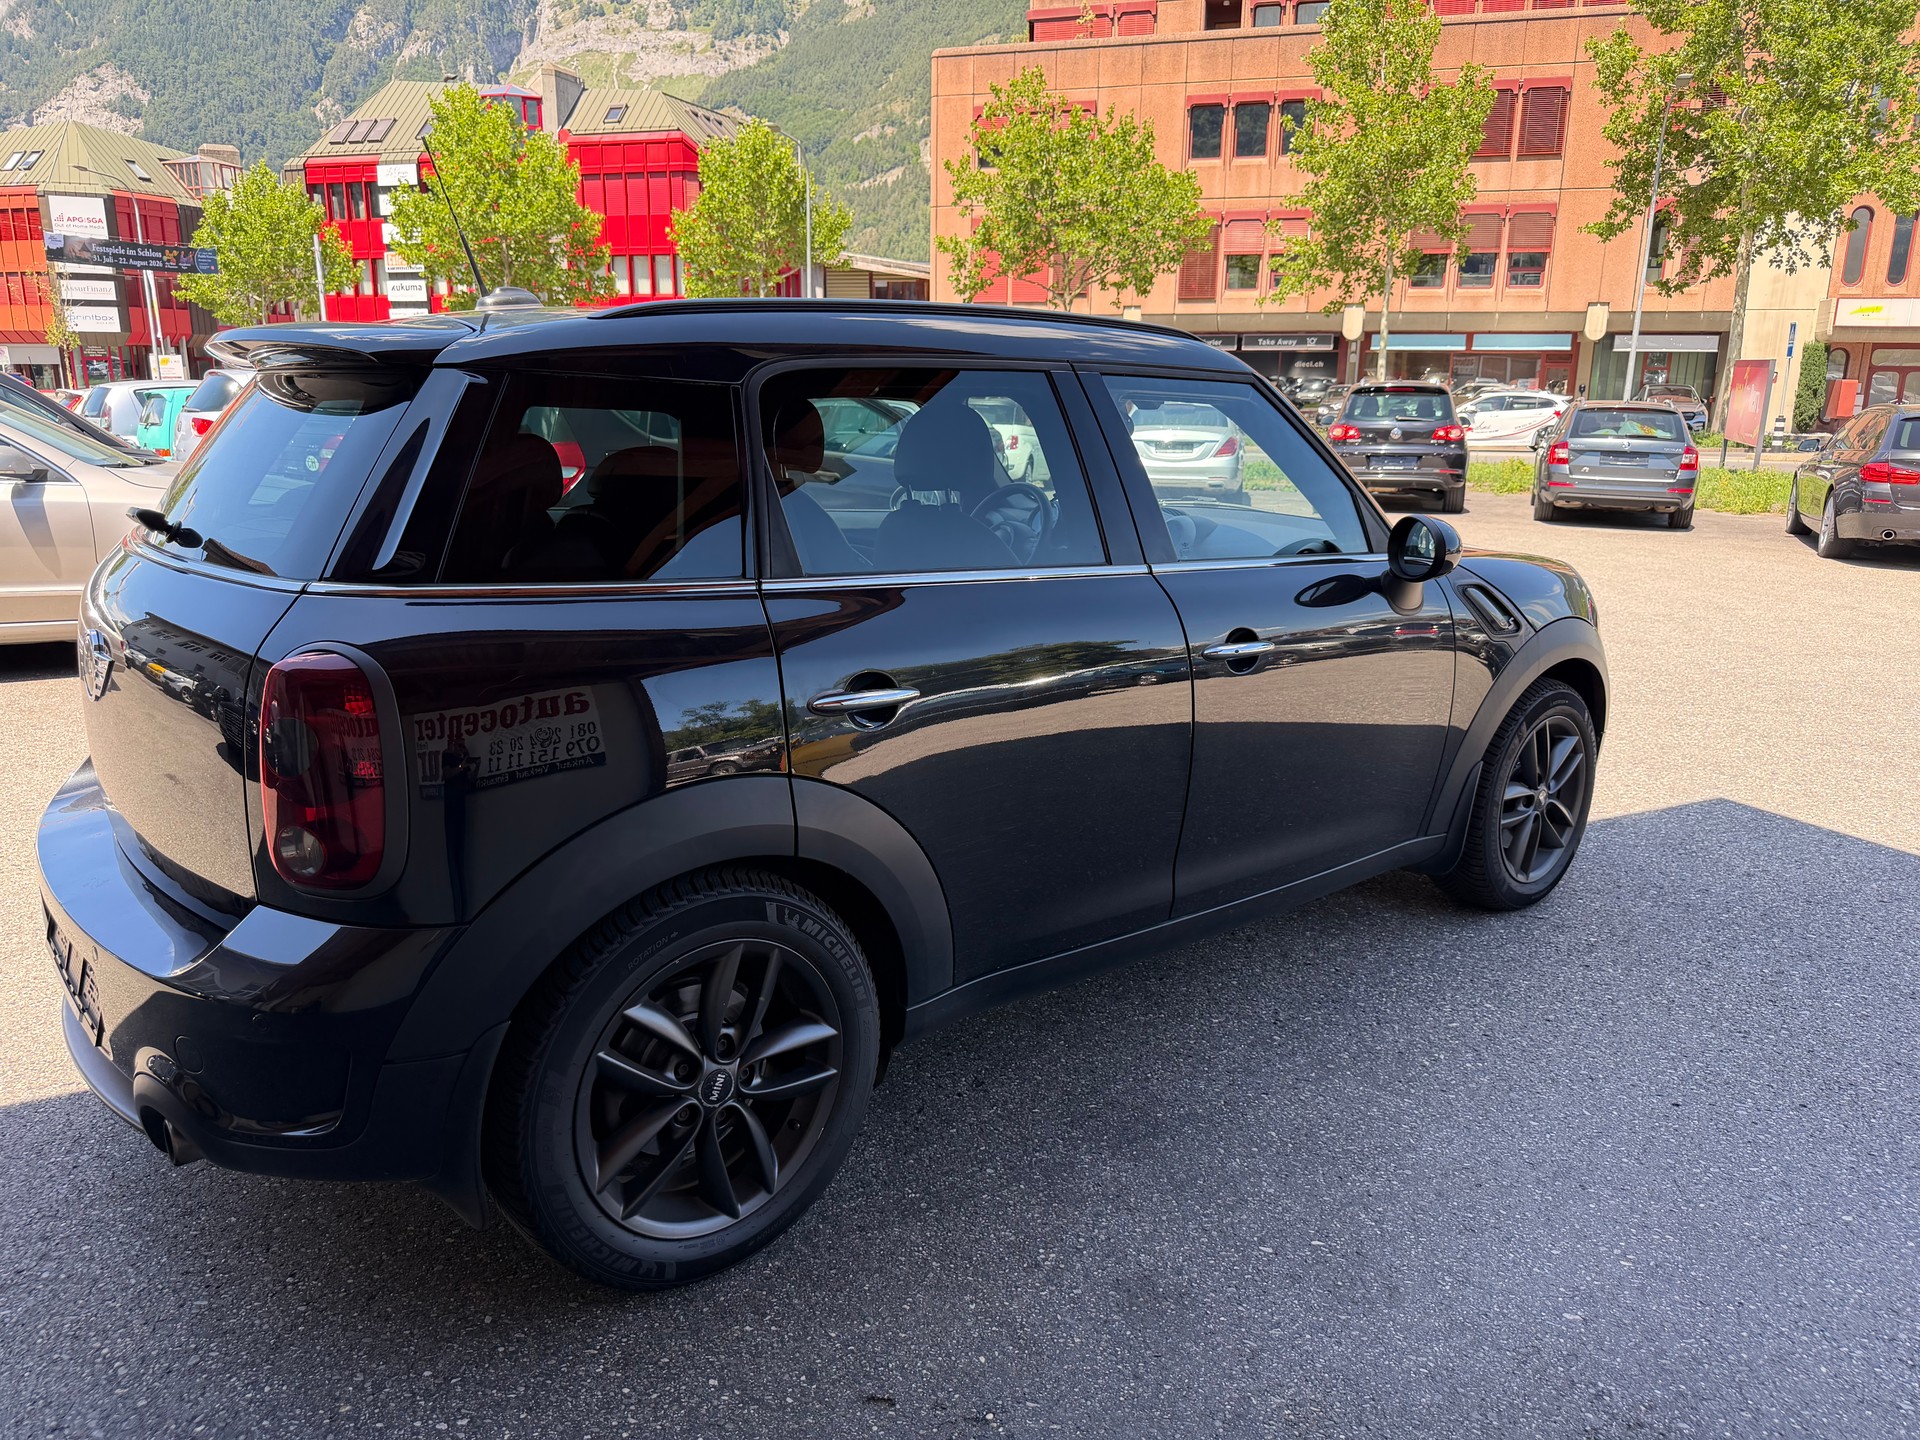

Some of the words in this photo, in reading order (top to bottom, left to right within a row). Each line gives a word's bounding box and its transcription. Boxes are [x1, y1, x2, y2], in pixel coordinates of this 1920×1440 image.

[92, 243, 125, 255] Festspiele
[126, 247, 136, 255] im
[137, 249, 162, 258] Schloss
[103, 255, 114, 263] Juli
[129, 258, 148, 268] August
[1258, 338, 1275, 346] Take
[1278, 338, 1297, 347] Away
[1294, 360, 1324, 368] dieci.ch
[627, 935, 669, 971] ROTATION
[801, 918, 868, 1002] MICHELIN
[708, 1072, 726, 1101] MINI
